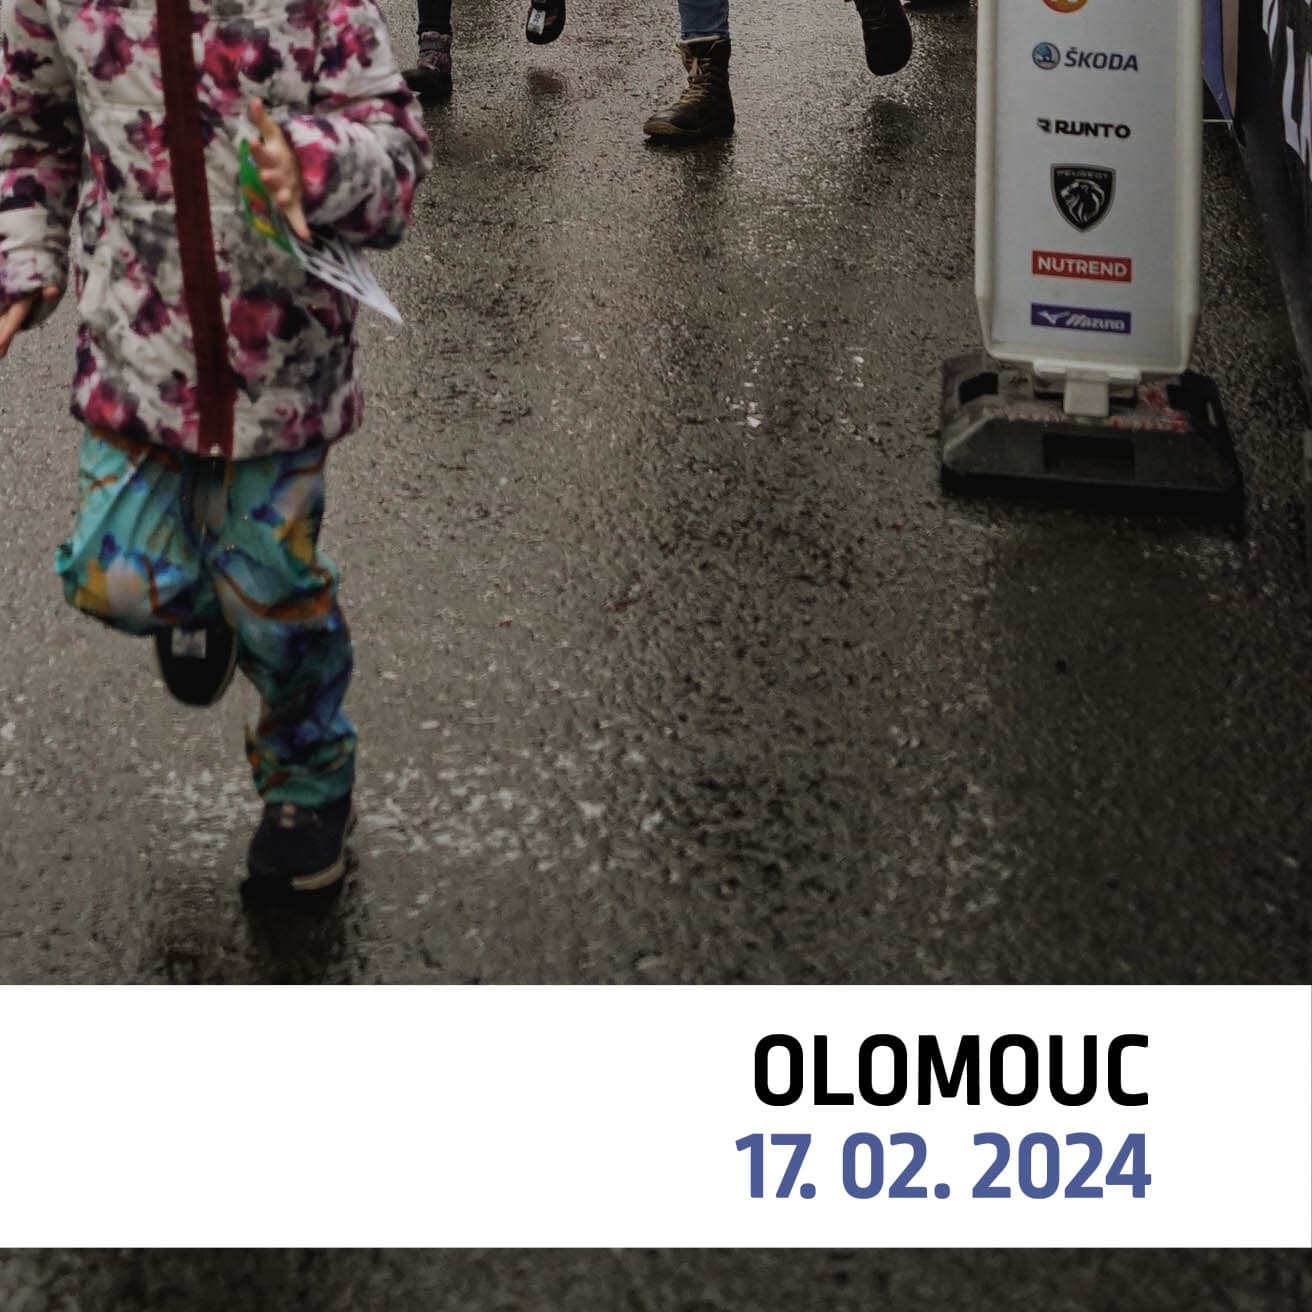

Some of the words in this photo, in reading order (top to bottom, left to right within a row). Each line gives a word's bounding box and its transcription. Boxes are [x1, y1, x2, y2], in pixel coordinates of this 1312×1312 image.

[1064, 46, 1139, 73] ŠKODA
[1055, 119, 1131, 139] RUNTO
[1038, 256, 1128, 277] NUTREND
